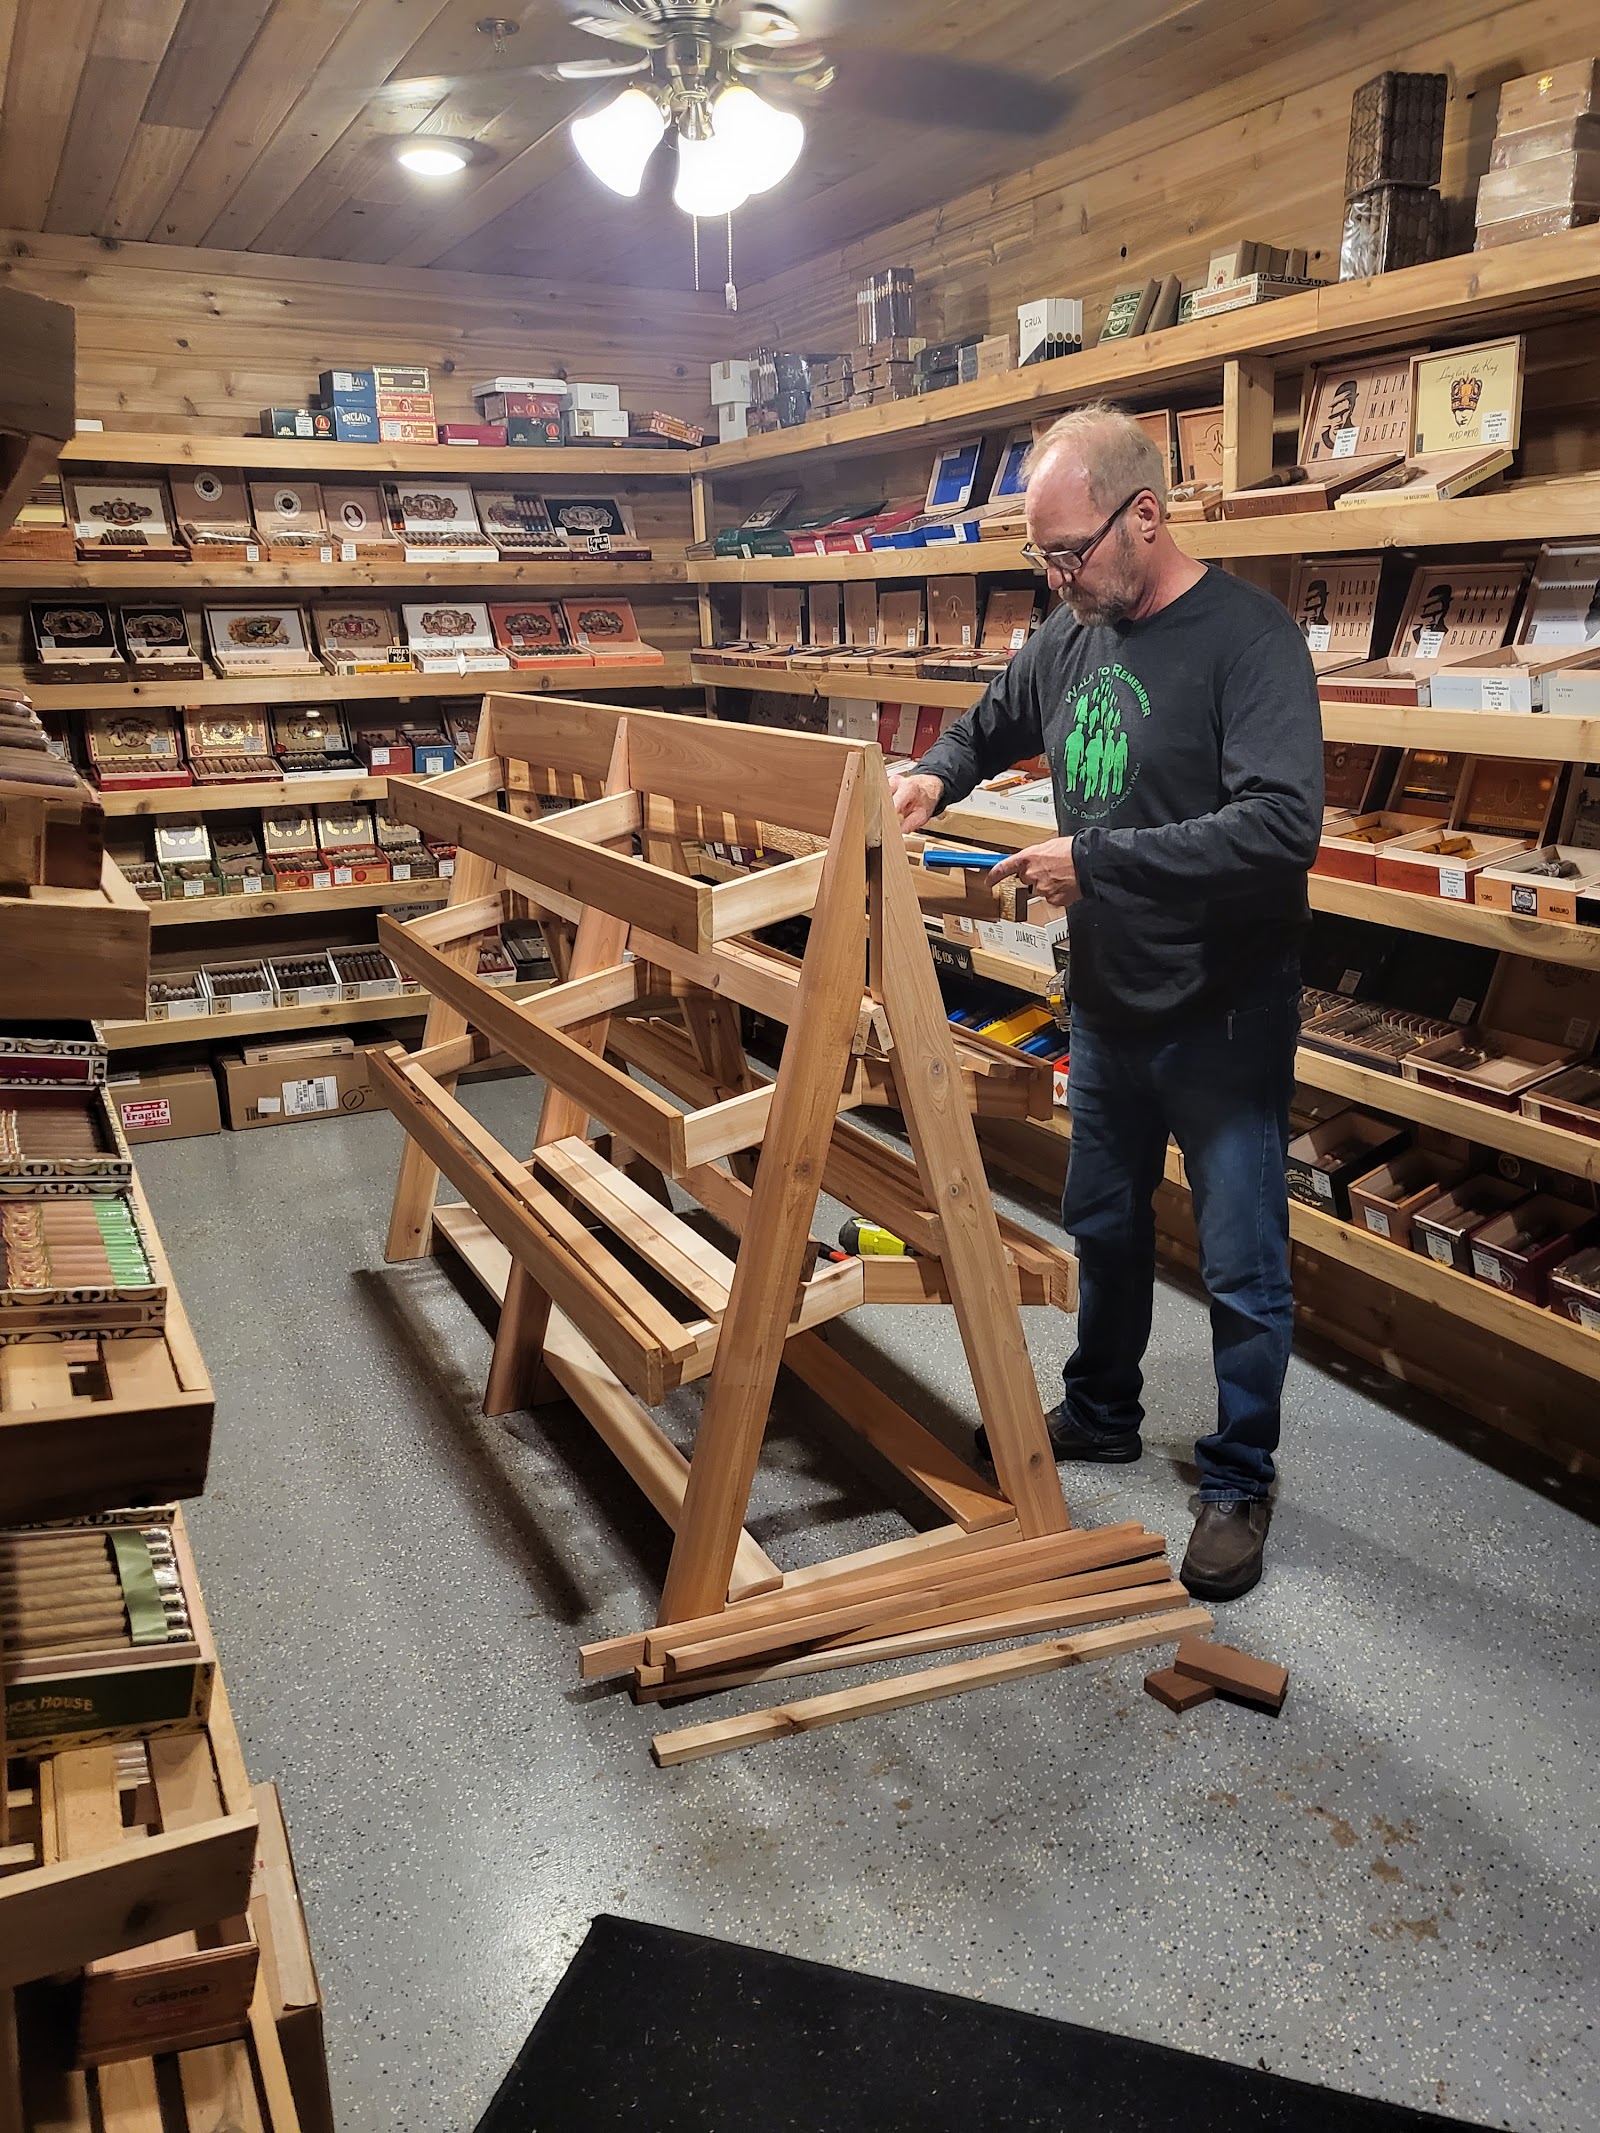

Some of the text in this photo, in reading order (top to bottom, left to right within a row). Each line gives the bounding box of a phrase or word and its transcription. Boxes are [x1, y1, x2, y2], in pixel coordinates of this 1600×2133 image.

[1024, 316, 1042, 328] CRUX
[1373, 374, 1408, 396] BLIN
[1363, 421, 1406, 443] BLUFF
[1340, 580, 1376, 596] BLIND
[1463, 585, 1509, 601] BLIND
[1337, 601, 1373, 617] MAN'S
[1457, 607, 1504, 624] MAN'S
[1334, 622, 1371, 638] BLUFF
[1450, 630, 1497, 646] BLUFF
[1065, 663, 1152, 719] WALK TO REMEMBER
[1481, 893, 1493, 901] TORO
[1549, 906, 1570, 915] MADURO
[126, 1110, 167, 1121] fragile
[40, 1696, 94, 1711] HOUSE
